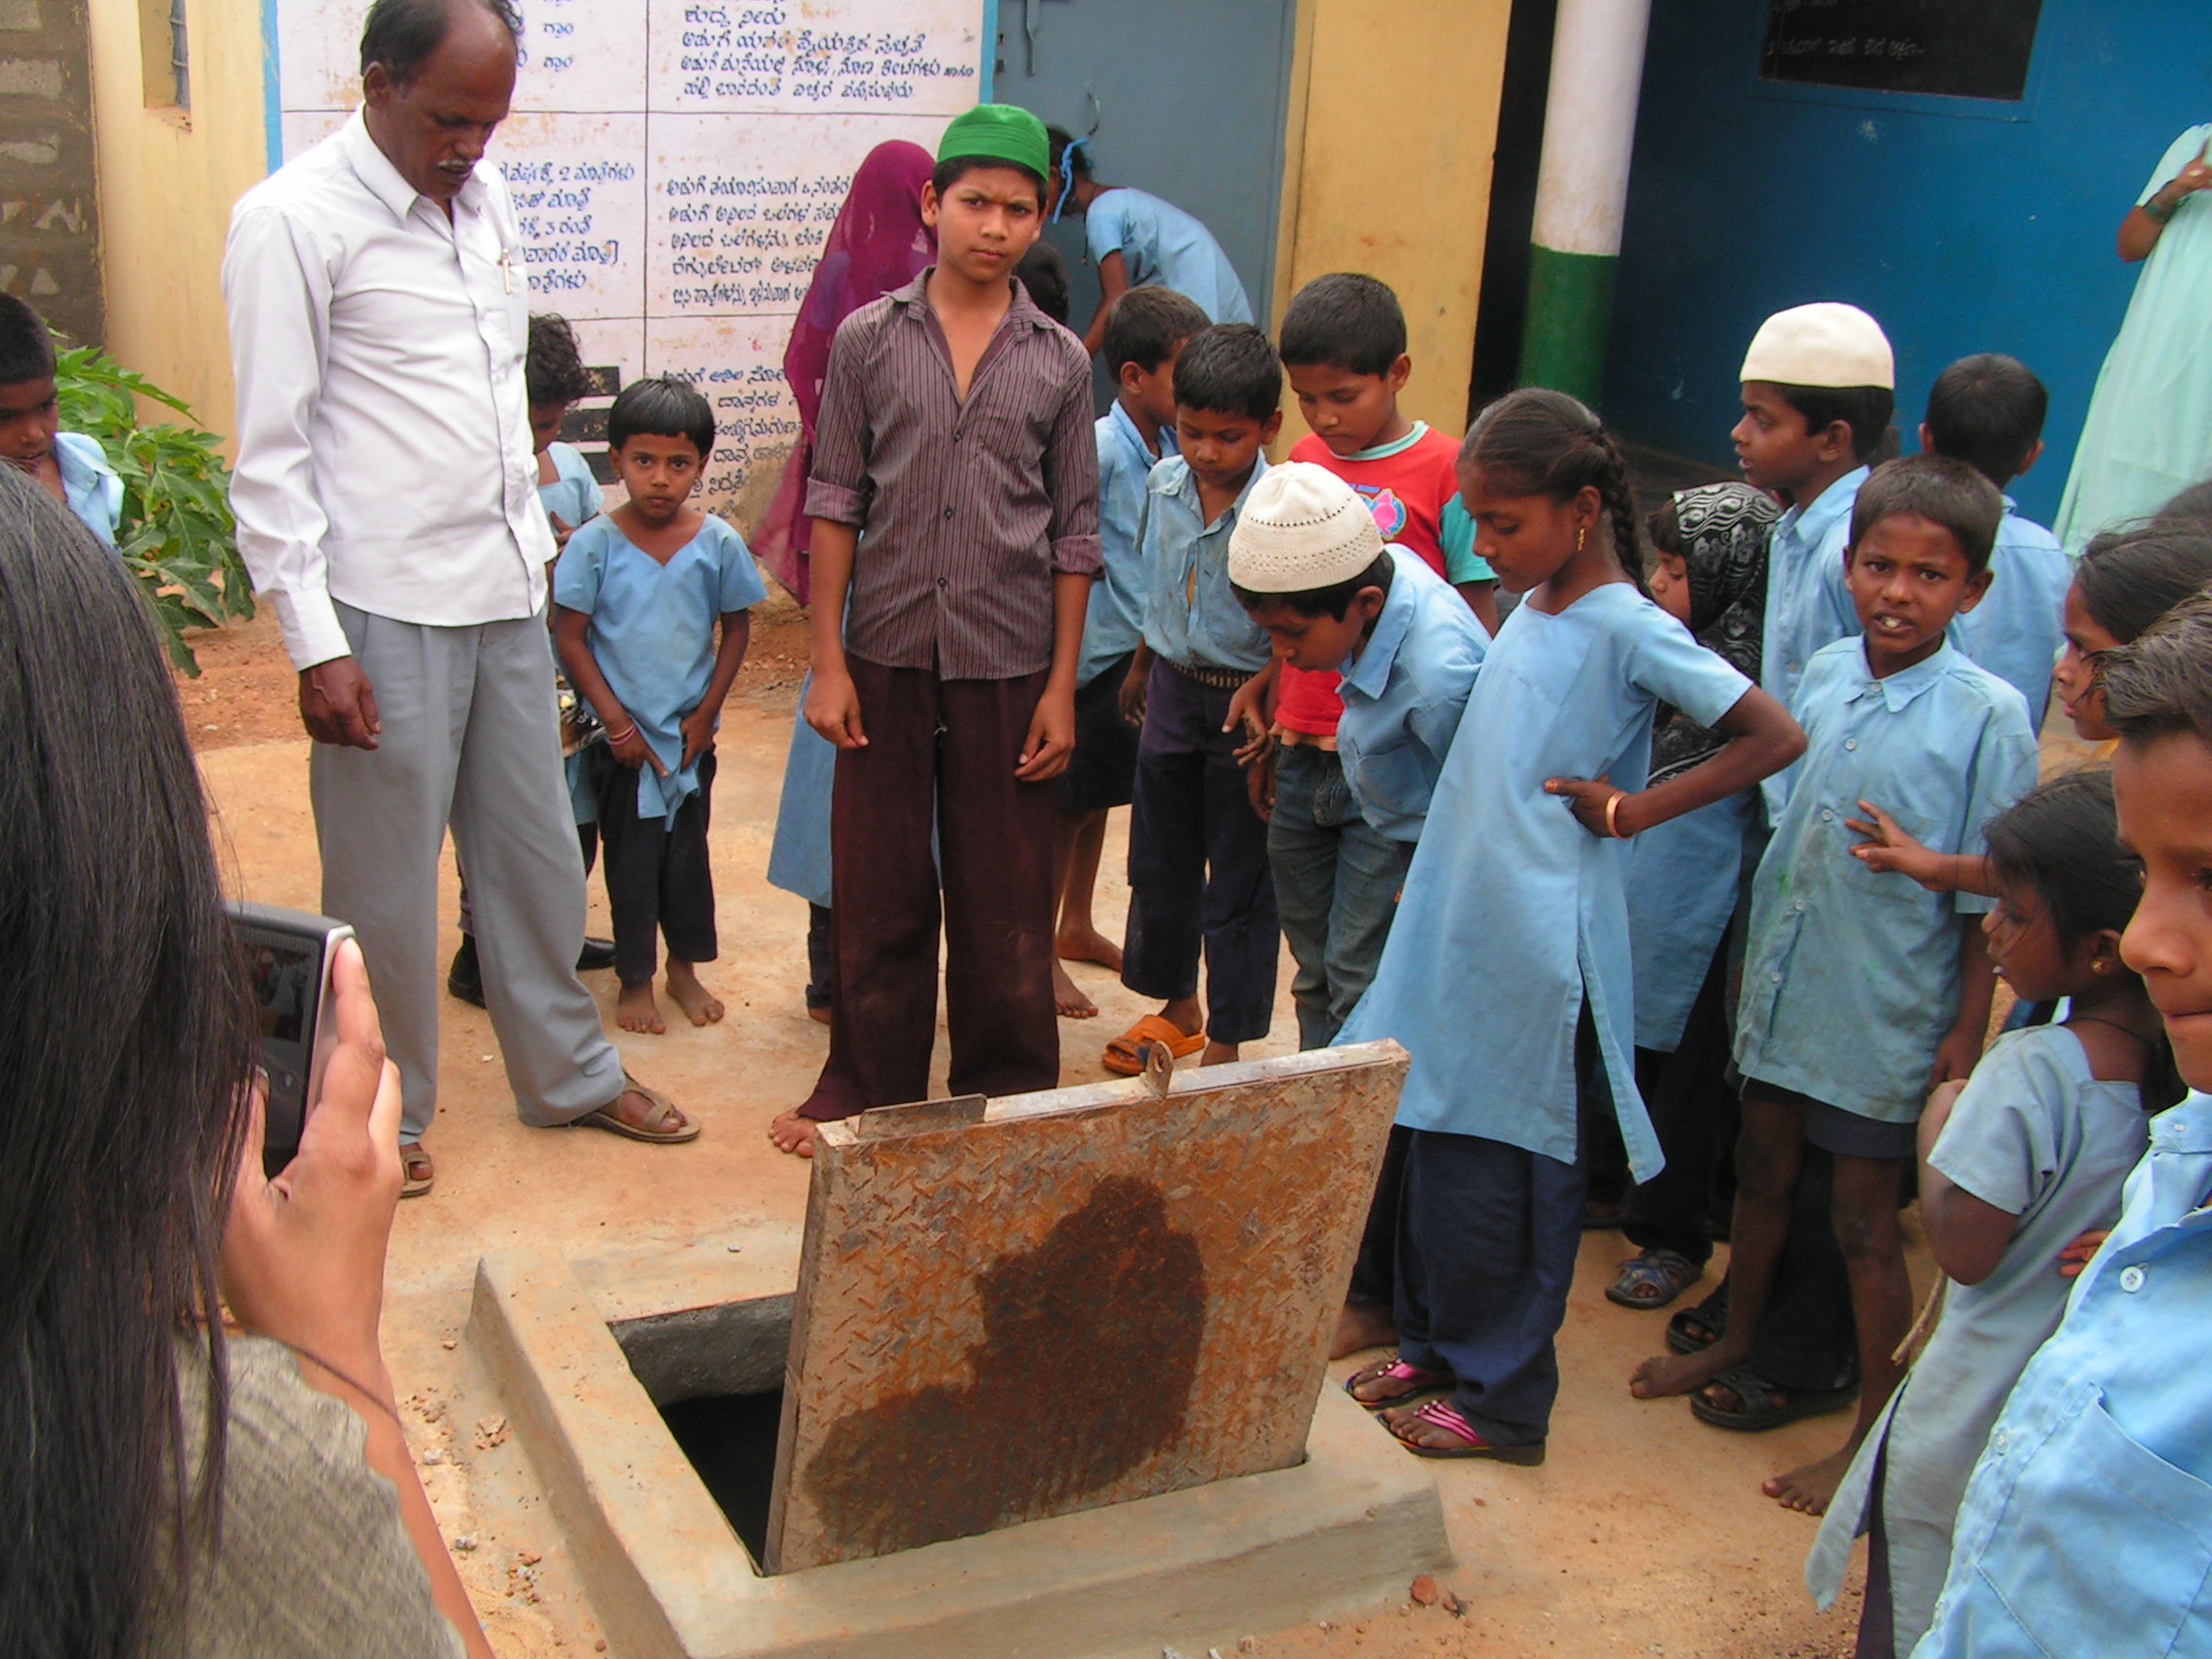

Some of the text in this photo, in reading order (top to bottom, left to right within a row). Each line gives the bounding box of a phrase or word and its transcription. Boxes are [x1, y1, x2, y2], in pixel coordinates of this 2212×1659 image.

[738, 7, 786, 28] ನೀರು
[559, 166, 571, 181] 2
[666, 175, 707, 196] ಅಡುಗೆ
[669, 203, 710, 222] ಅಡುಗೆ
[545, 221, 555, 235] 3
